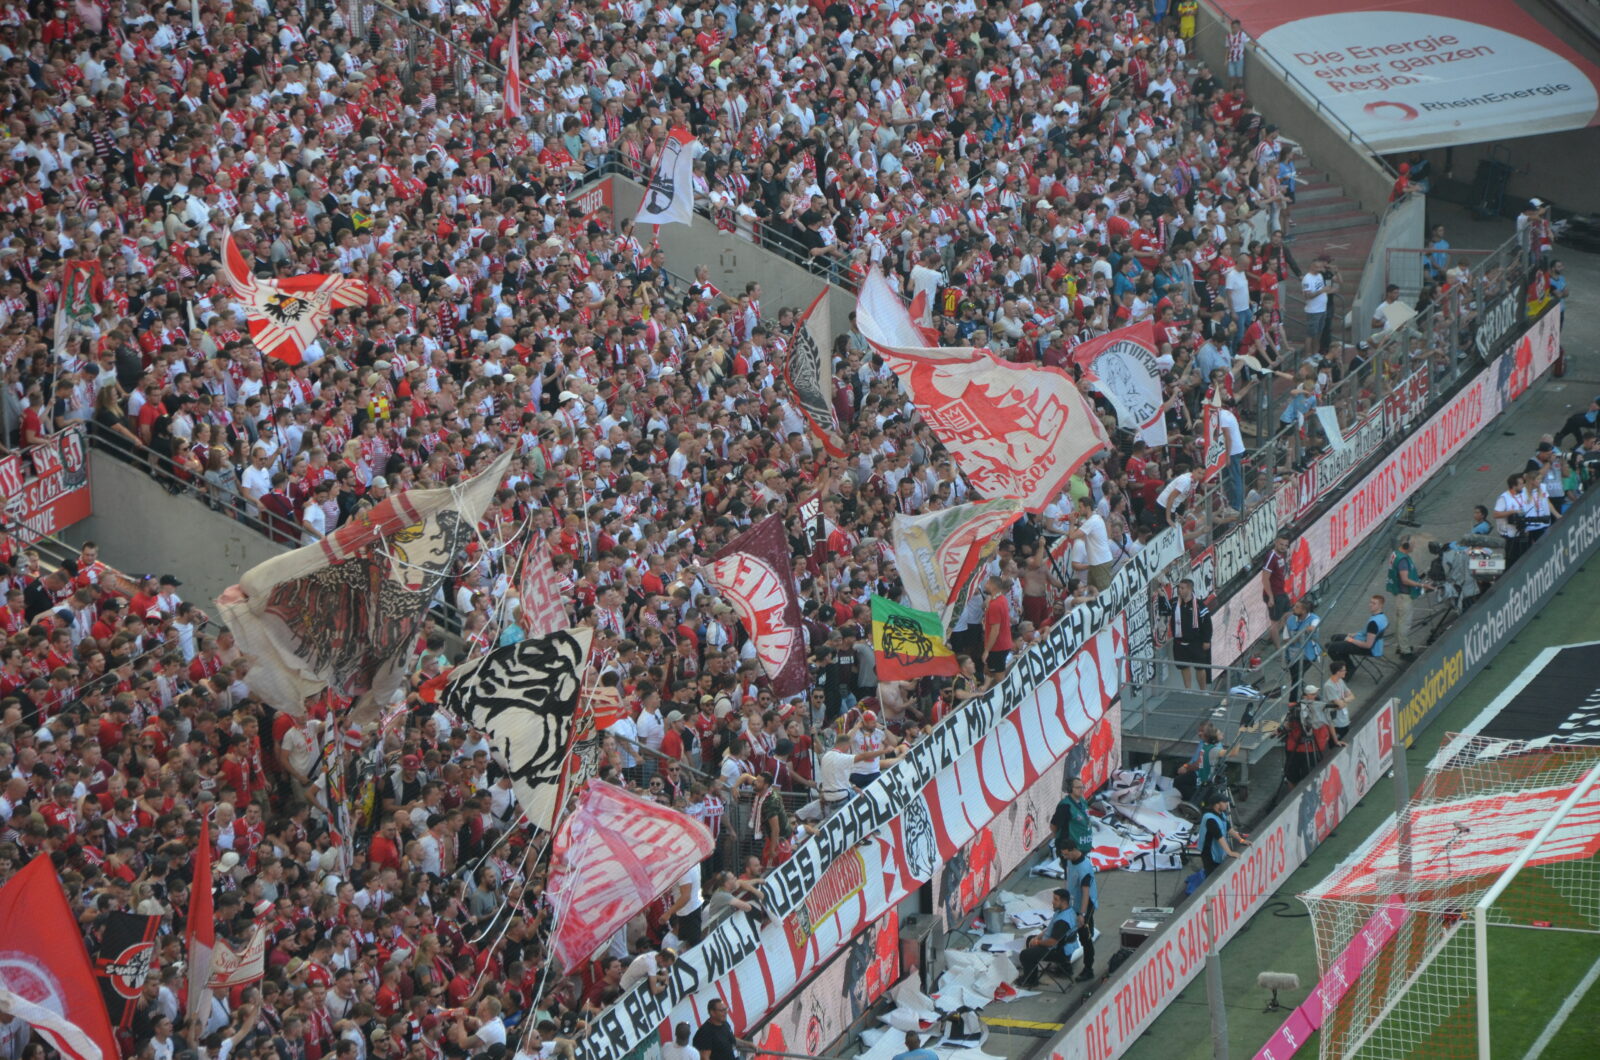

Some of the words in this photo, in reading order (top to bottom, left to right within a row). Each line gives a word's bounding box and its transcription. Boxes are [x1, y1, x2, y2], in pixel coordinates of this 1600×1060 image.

[1293, 50, 1345, 66] Die
[1346, 32, 1459, 60] Energie
[1314, 60, 1382, 79] einer
[1388, 43, 1494, 73] ganzen
[1421, 81, 1571, 112] RheinEnergie
[1329, 494, 1349, 559] DIE
[1352, 461, 1398, 531] TRIKOTS
[1401, 422, 1438, 493] SAISON
[1440, 382, 1482, 456] 2022/23
[1464, 539, 1566, 671] Küchenfachmarkt
[818, 763, 907, 875] SCHALKE
[905, 727, 961, 798] JETZT
[964, 690, 996, 746] MIT
[1001, 614, 1086, 718] GLADBACH
[1090, 549, 1150, 633] CHILLEN
[1086, 1006, 1112, 1060] DIE
[1114, 940, 1175, 1043] TRIKOTS
[1178, 884, 1229, 977] SAISON
[1231, 826, 1286, 922] 2022/23
